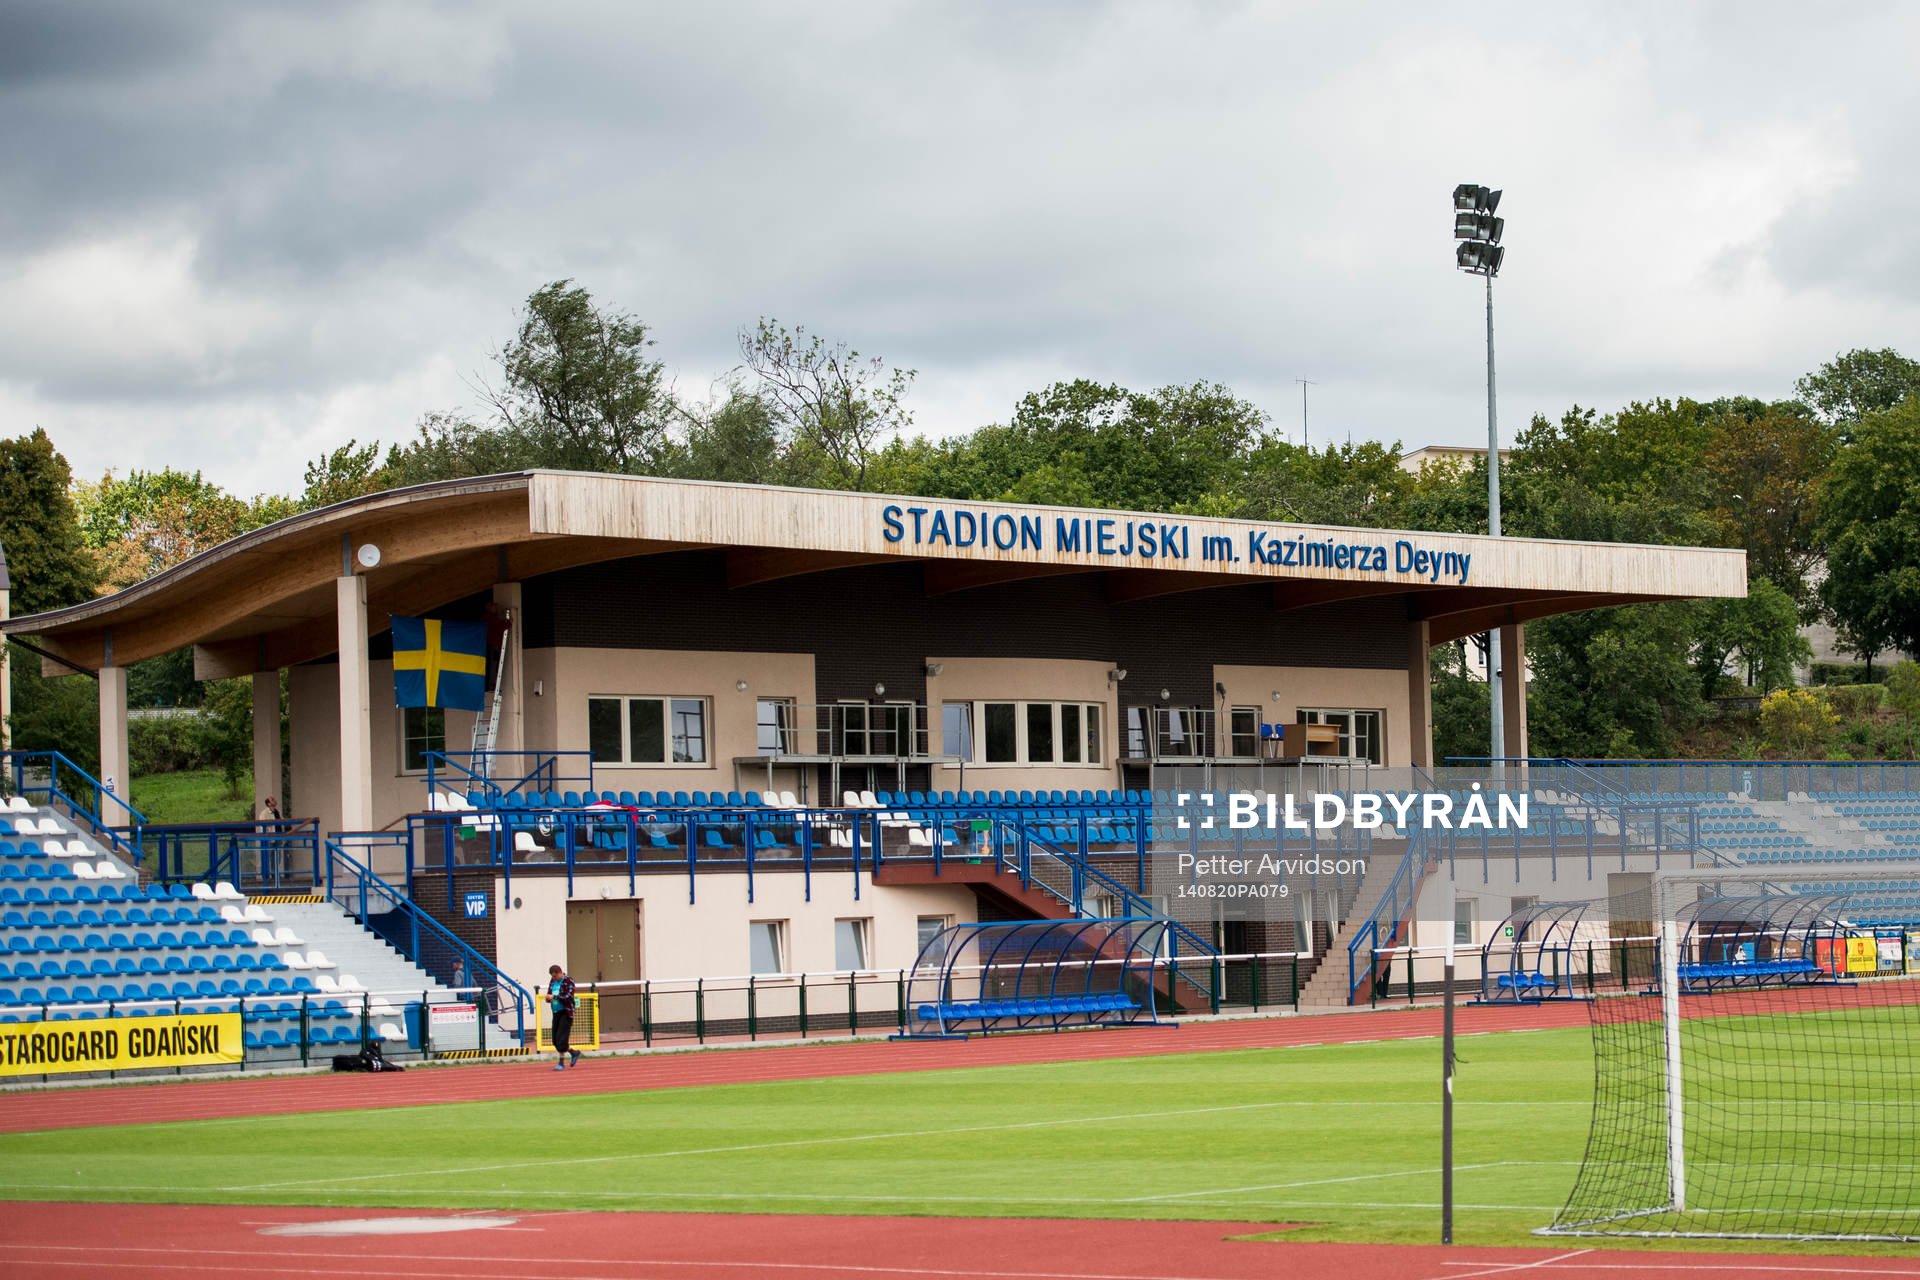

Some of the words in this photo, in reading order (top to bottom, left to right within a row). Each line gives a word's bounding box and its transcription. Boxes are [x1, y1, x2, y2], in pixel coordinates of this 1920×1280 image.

[883, 504, 1042, 550] STADION
[1056, 517, 1189, 558] MIEJSKI
[1202, 536, 1240, 563] im.
[1249, 531, 1388, 571] Kazimierza
[1395, 541, 1471, 584] Deyny
[465, 901, 486, 916] VIP
[128, 1020, 219, 1059] GDAŃSKI
